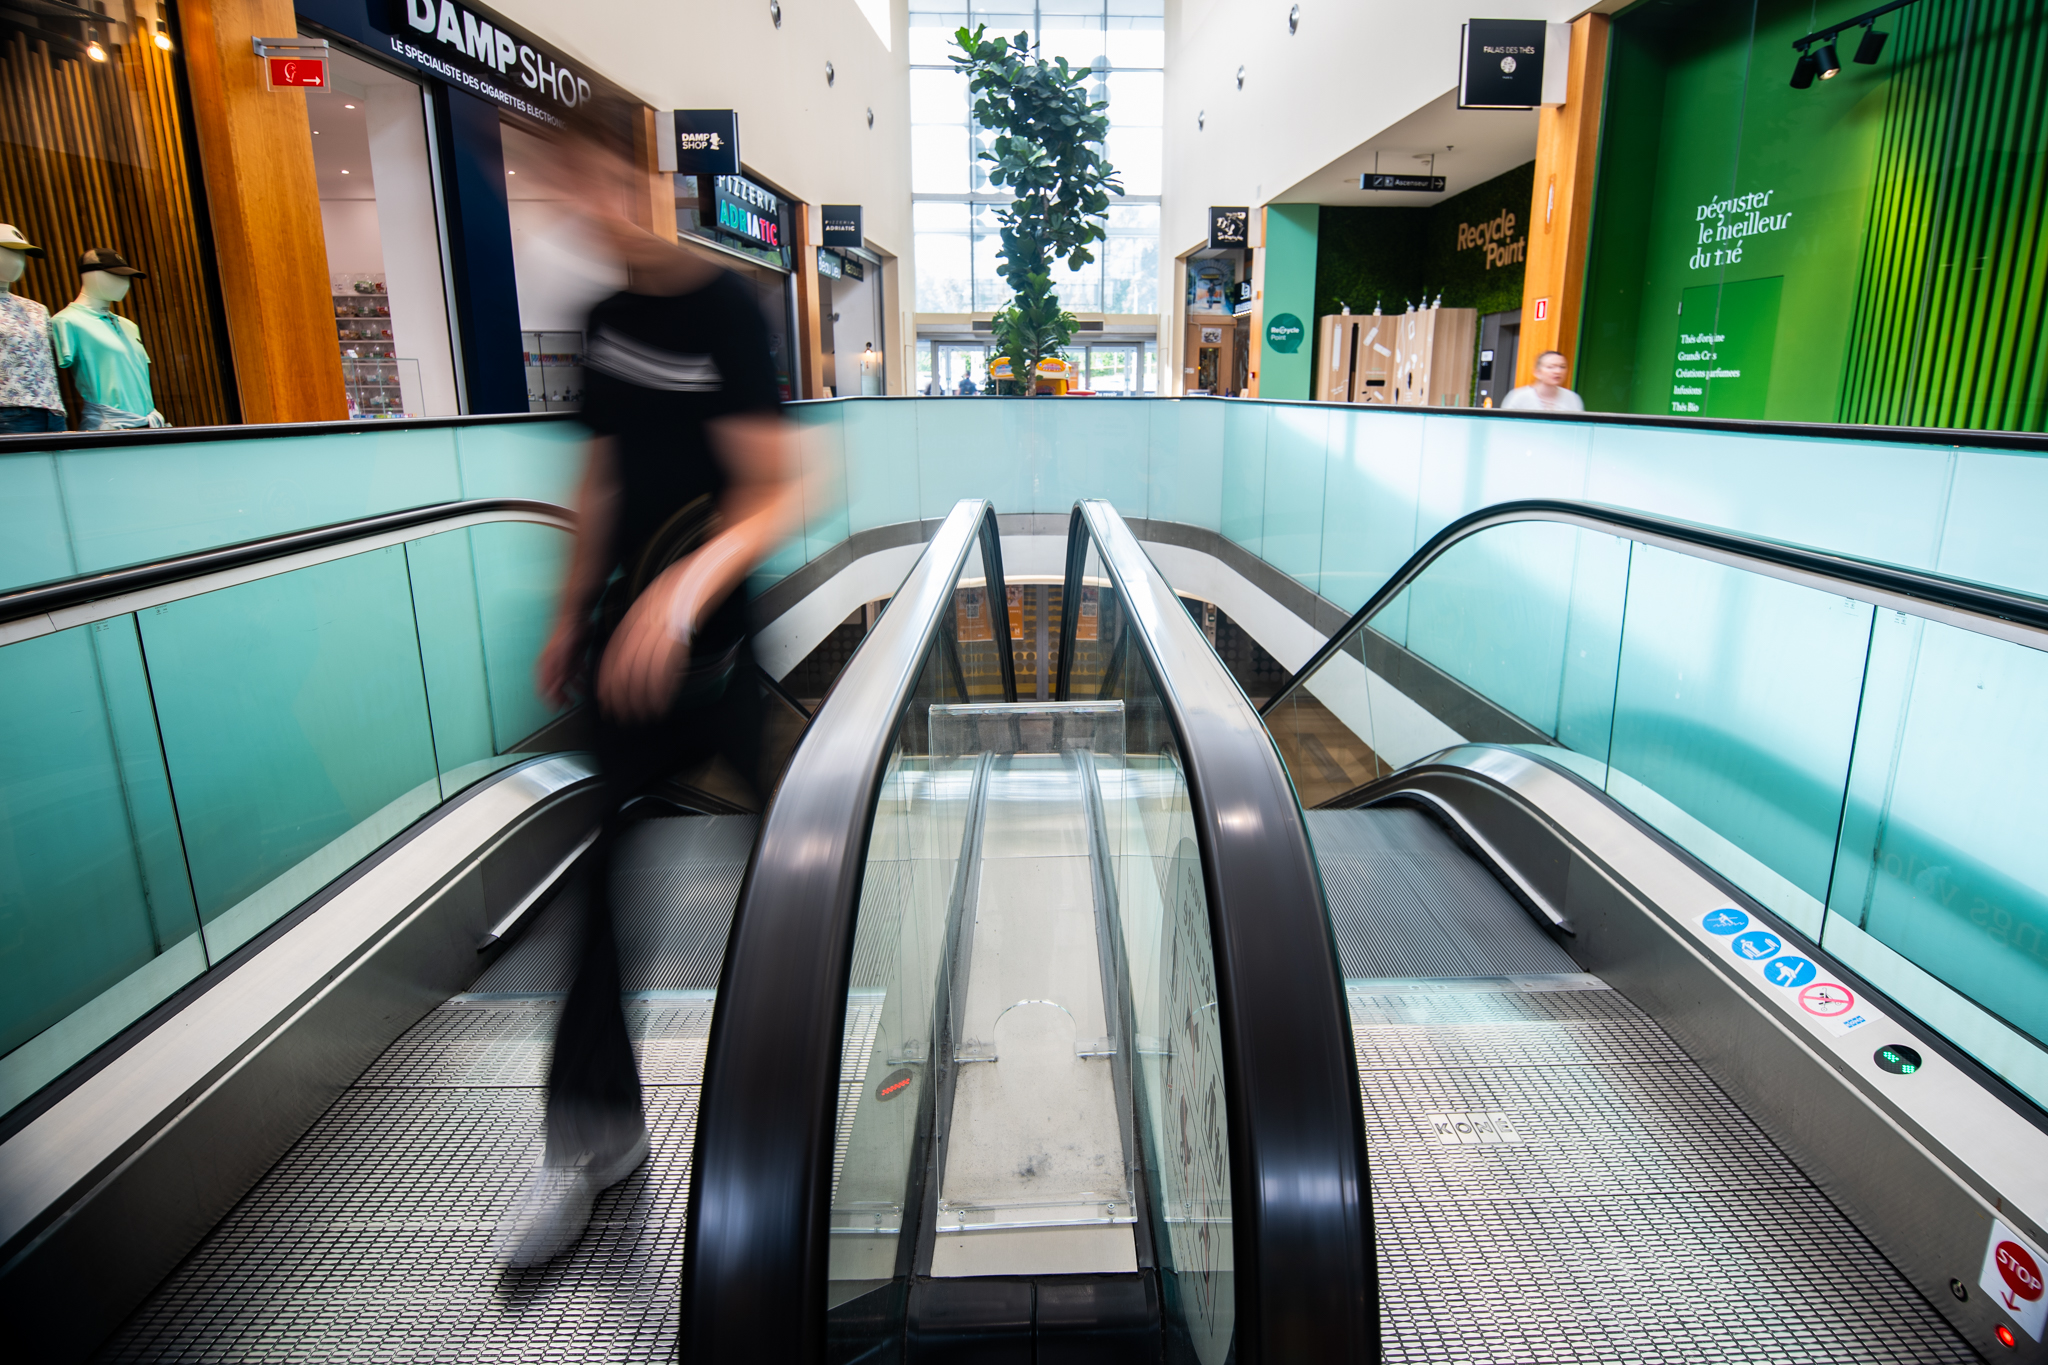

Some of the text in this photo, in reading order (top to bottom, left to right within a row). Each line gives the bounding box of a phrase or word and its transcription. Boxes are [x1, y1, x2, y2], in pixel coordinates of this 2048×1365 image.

[406, 0, 592, 109] DAMP SHOP
[1483, 45, 1505, 54] PALAIS
[1506, 46, 1518, 54] DES
[391, 37, 404, 55] LE
[404, 44, 462, 82] SPECIALISTE
[462, 72, 480, 91] DES
[480, 81, 526, 112] CIGARETTES
[681, 132, 710, 142] DAMP
[682, 141, 708, 150] SHOP
[718, 174, 778, 216] PIZZERIA
[1394, 178, 1429, 187] Ascenseur
[719, 199, 778, 247] ADRIATIC
[1695, 189, 1774, 227] Déguster
[1456, 208, 1516, 252] Recycle
[1696, 211, 1793, 245] le meilleur
[1485, 235, 1527, 270] Point
[1689, 246, 1712, 270] du
[1677, 349, 1718, 362] Grands Crs
[1673, 384, 1703, 396] Infusions
[1687, 401, 1700, 412] Bio
[1996, 1247, 2042, 1290] STOP
